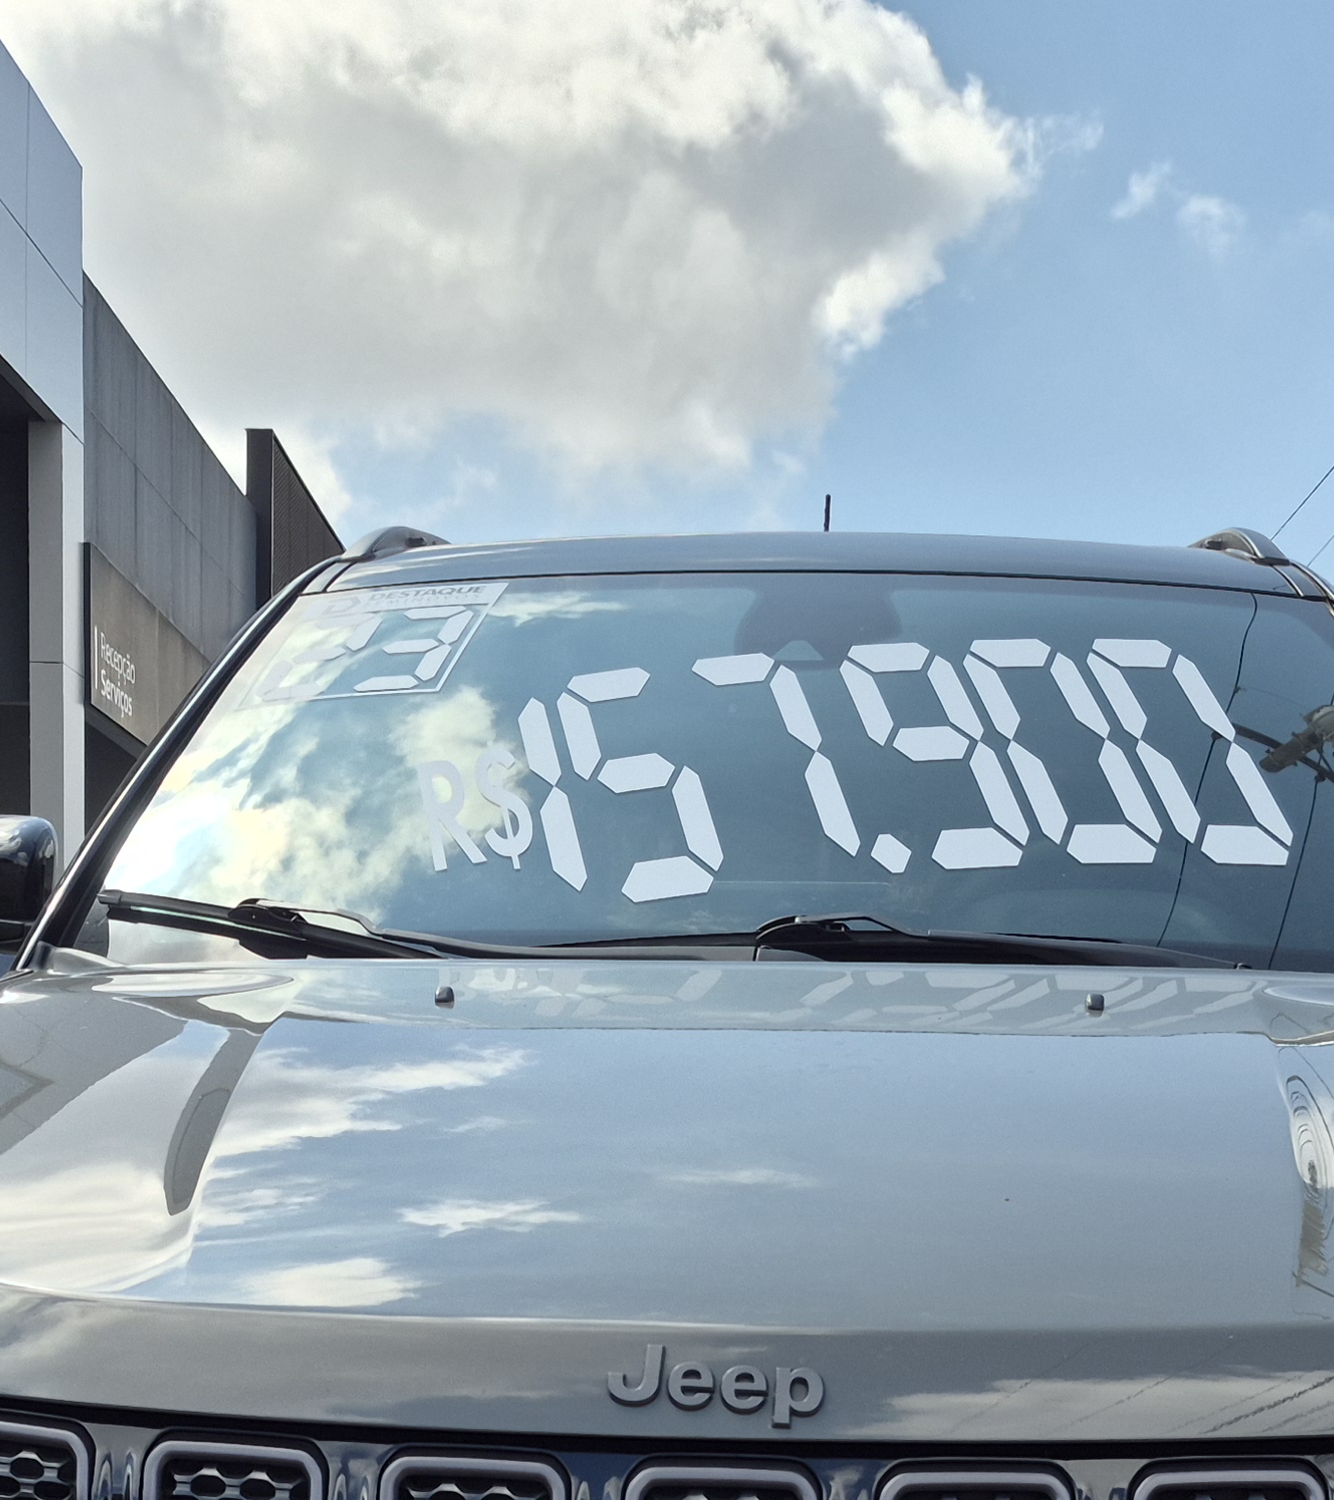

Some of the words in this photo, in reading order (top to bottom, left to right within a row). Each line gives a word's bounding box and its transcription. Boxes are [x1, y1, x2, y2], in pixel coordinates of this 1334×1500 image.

[369, 585, 487, 600] DESTAQUE
[100, 632, 136, 686] Recepção
[100, 668, 133, 718] Serviços
[417, 740, 534, 872] R$
[518, 638, 1294, 902] 157.900
[608, 1344, 825, 1429] Jeep
